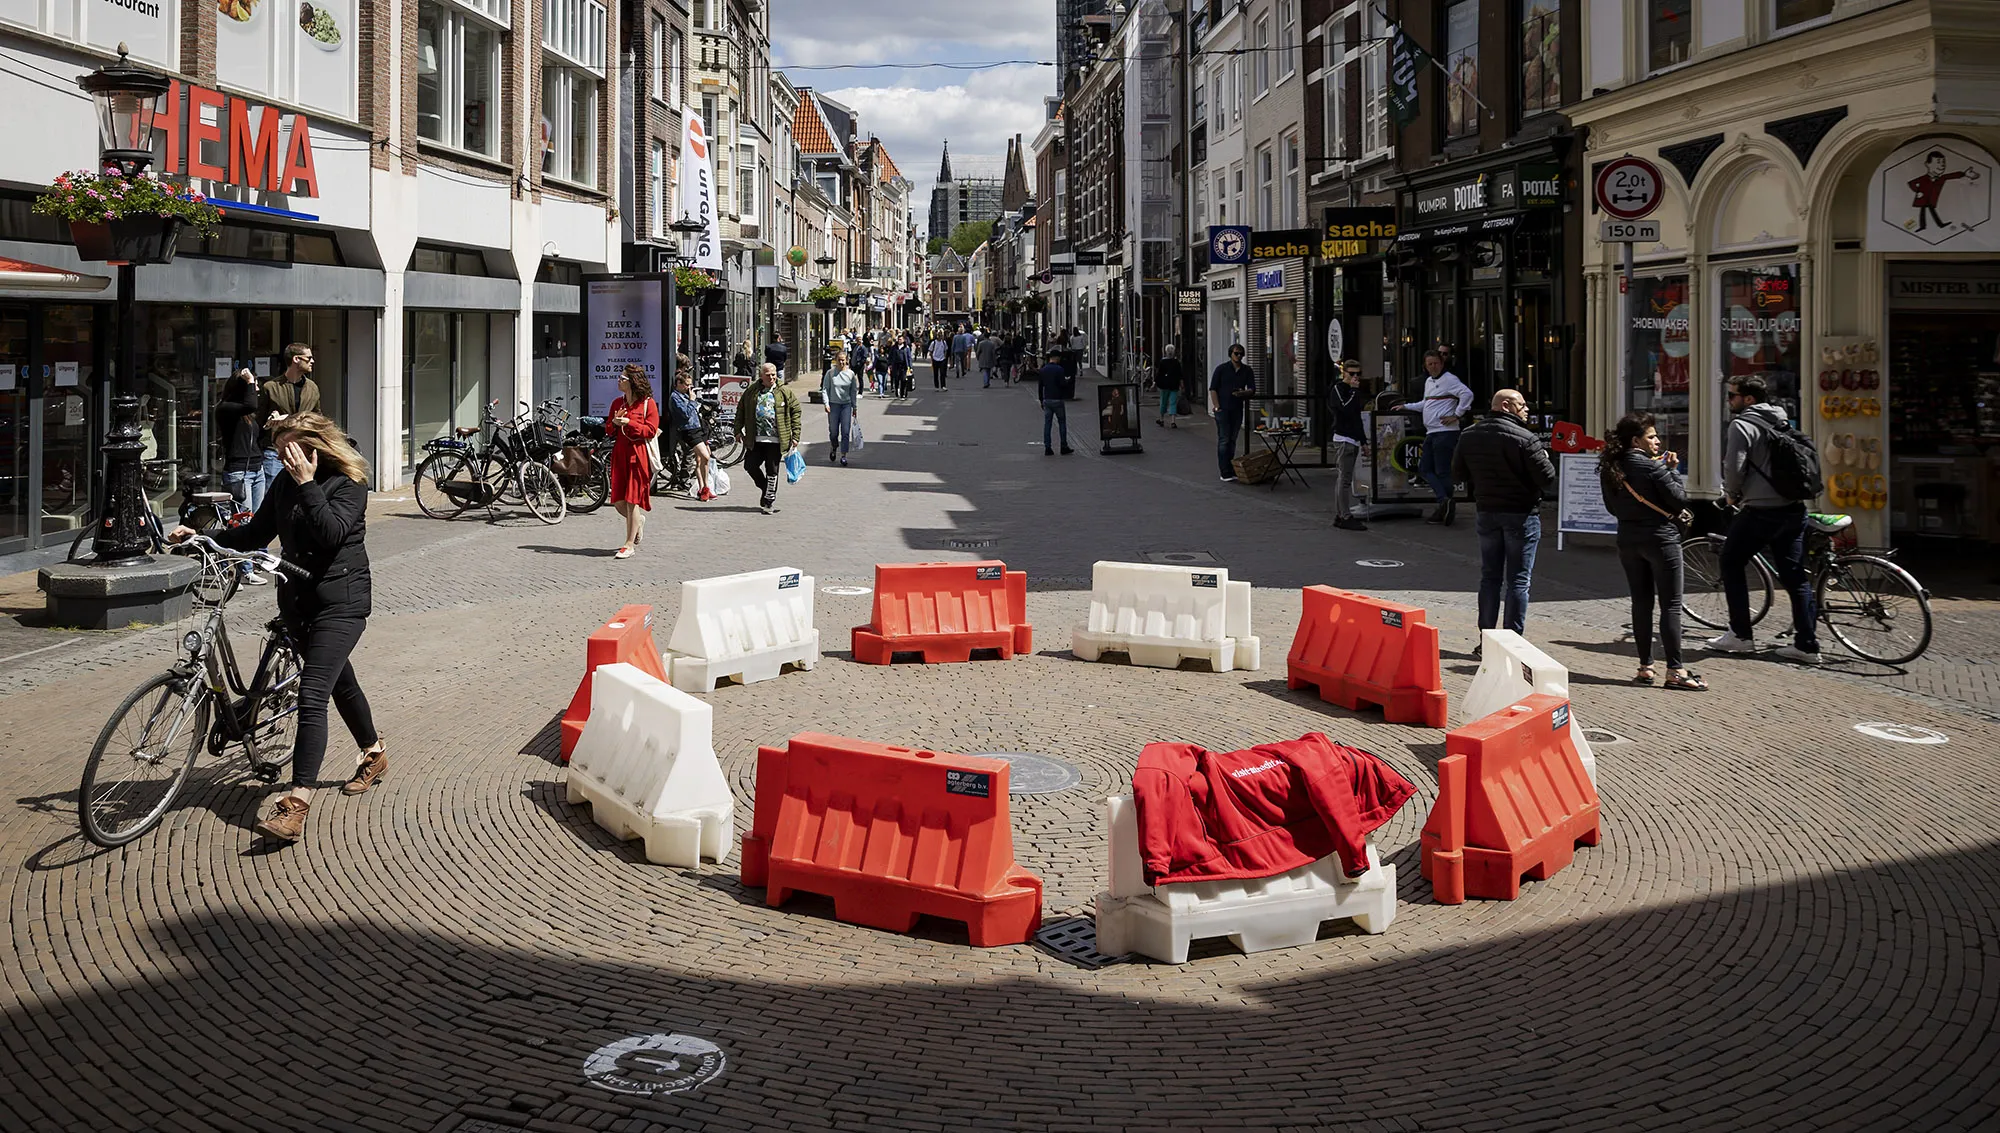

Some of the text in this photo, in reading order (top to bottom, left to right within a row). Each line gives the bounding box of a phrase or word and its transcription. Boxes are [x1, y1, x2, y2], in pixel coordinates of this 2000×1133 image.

[130, 79, 319, 199] HEMA
[1521, 174, 1560, 196] POTAÉ
[1418, 197, 1447, 214] KUMPIR
[1453, 173, 1484, 212] POTAÉ
[698, 168, 711, 257] UITGANG
[1329, 221, 1397, 238] sacha
[1482, 217, 1515, 229] ROTTERDAM
[1608, 225, 1654, 237] 150 m
[1252, 242, 1310, 258] sacha
[1900, 281, 1971, 294] MISTER
[601, 342, 648, 350] AND YOU?
[595, 365, 611, 373] 030
[947, 779, 976, 790] agterberg
